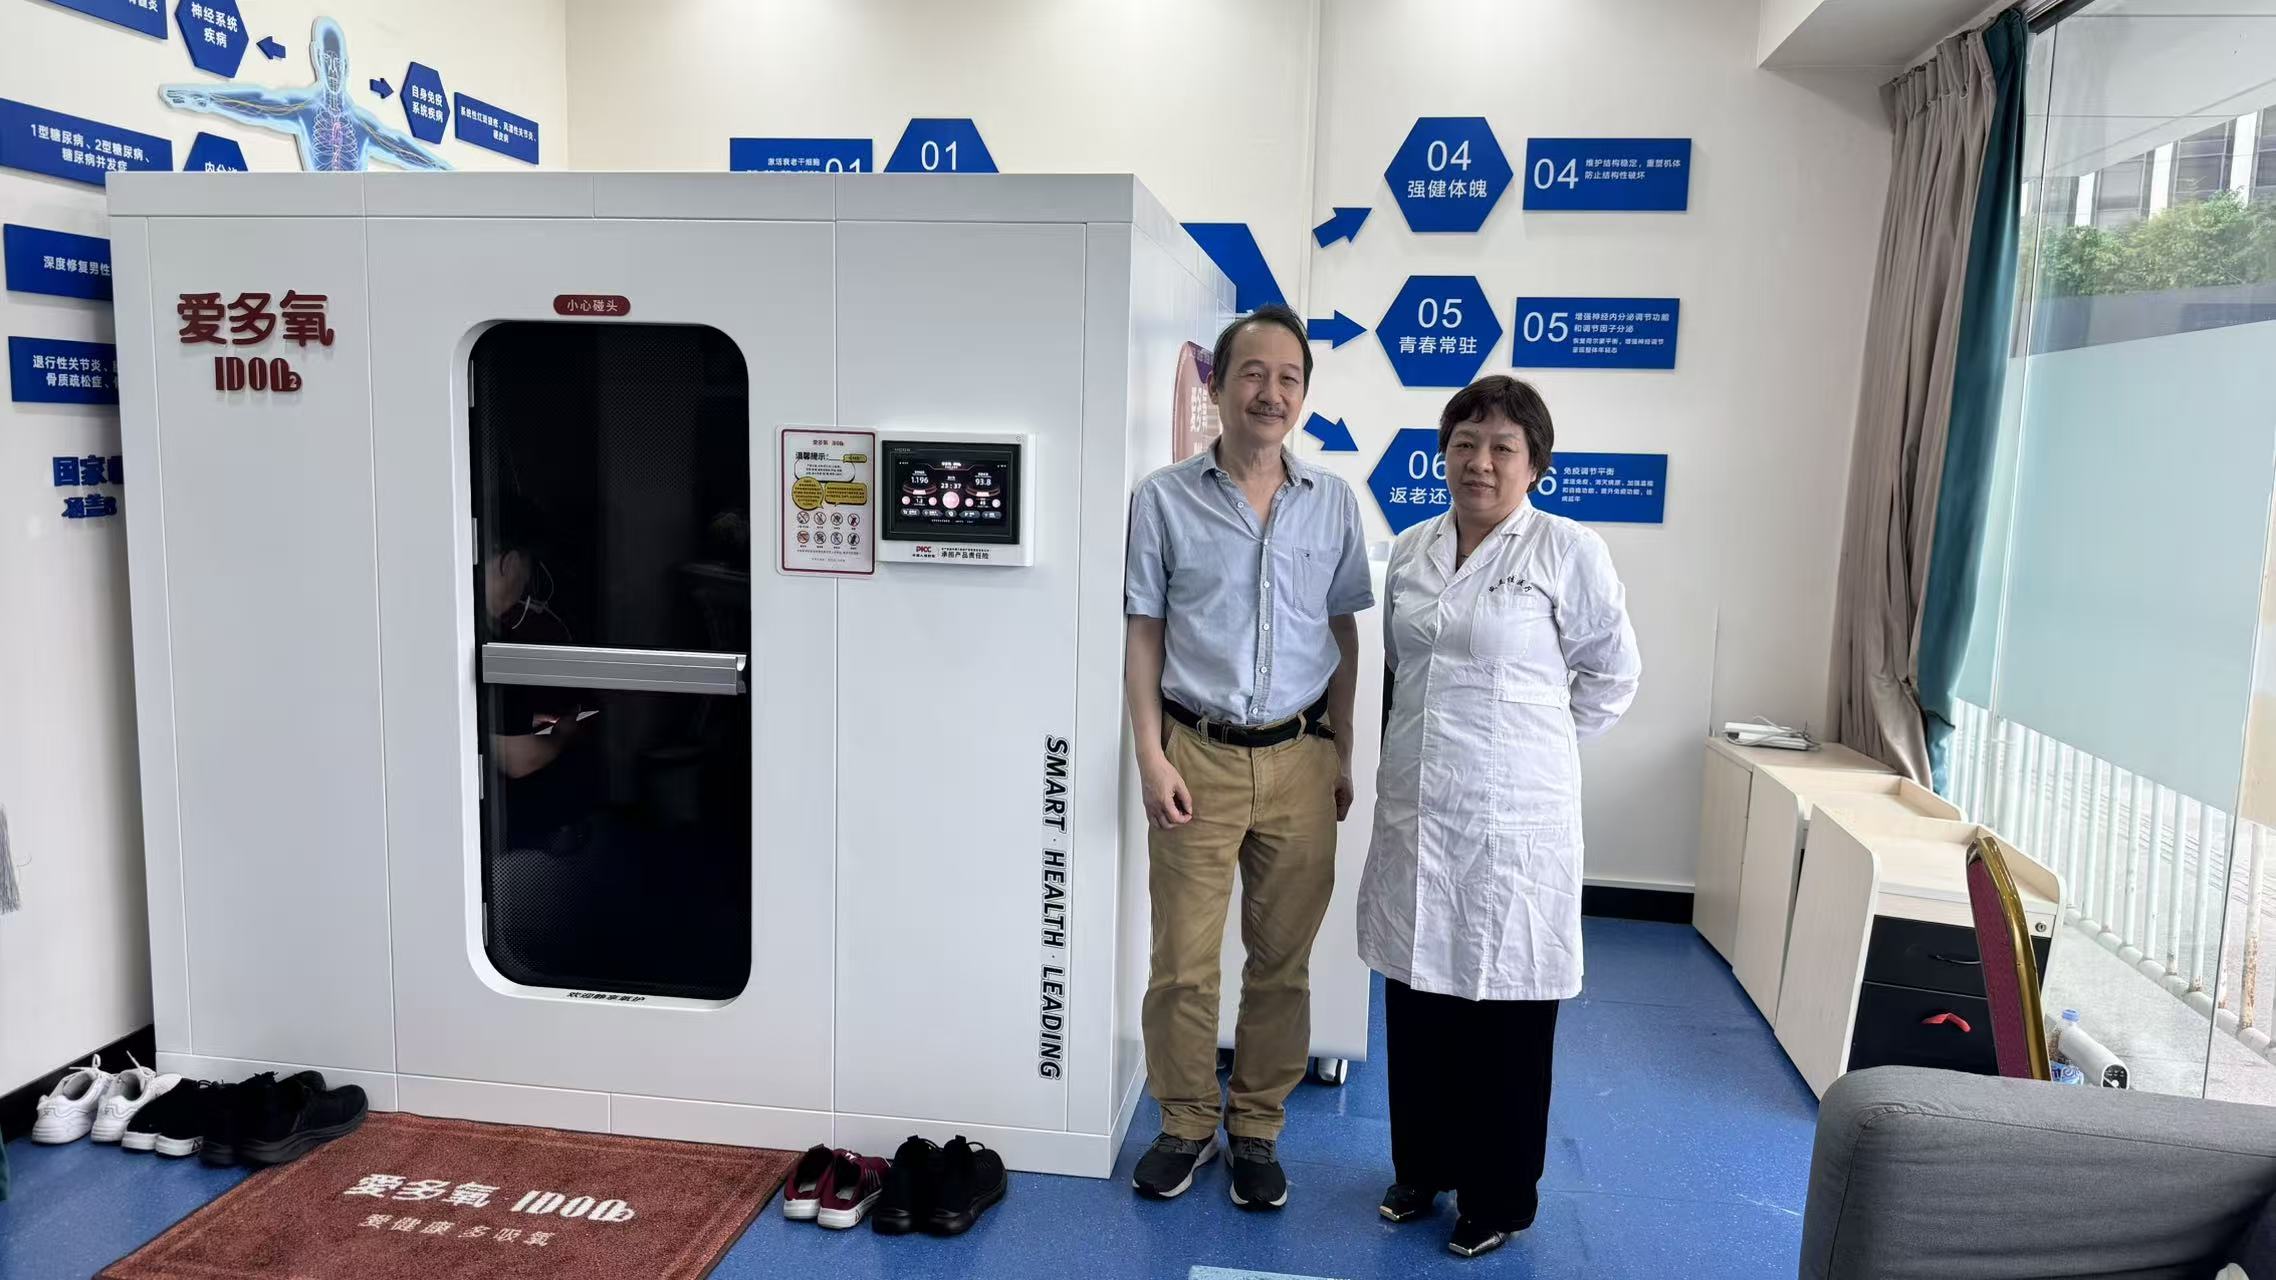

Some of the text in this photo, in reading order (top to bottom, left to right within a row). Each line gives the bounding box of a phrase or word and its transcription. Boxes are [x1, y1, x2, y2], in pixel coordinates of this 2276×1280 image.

[191, 2, 238, 32] 神经系统
[203, 28, 228, 48] 疾病
[411, 85, 443, 108] 自身免疫
[411, 102, 444, 123] 系统疾病
[31, 124, 150, 163] 1型糖尿病、2型糖尿病、
[921, 140, 958, 171] 01
[1427, 140, 1472, 171] 04
[61, 147, 128, 171] 糖尿病并发症
[1533, 158, 1579, 190] 04
[1584, 170, 1646, 180] 防止结构性破坏
[1407, 179, 1488, 199] 强健体魄
[177, 289, 335, 347] 爱多氧
[567, 299, 618, 312] 小心碰头
[1417, 298, 1463, 329] 05
[1523, 311, 1569, 343] 05
[1398, 336, 1478, 355] 青春常驻
[46, 373, 118, 389] 骨质疏松症、
[1537, 466, 1558, 496] 6
[1389, 486, 1454, 505] 返老还
[1038, 733, 1070, 1081] SMART HEALTH LEADING
